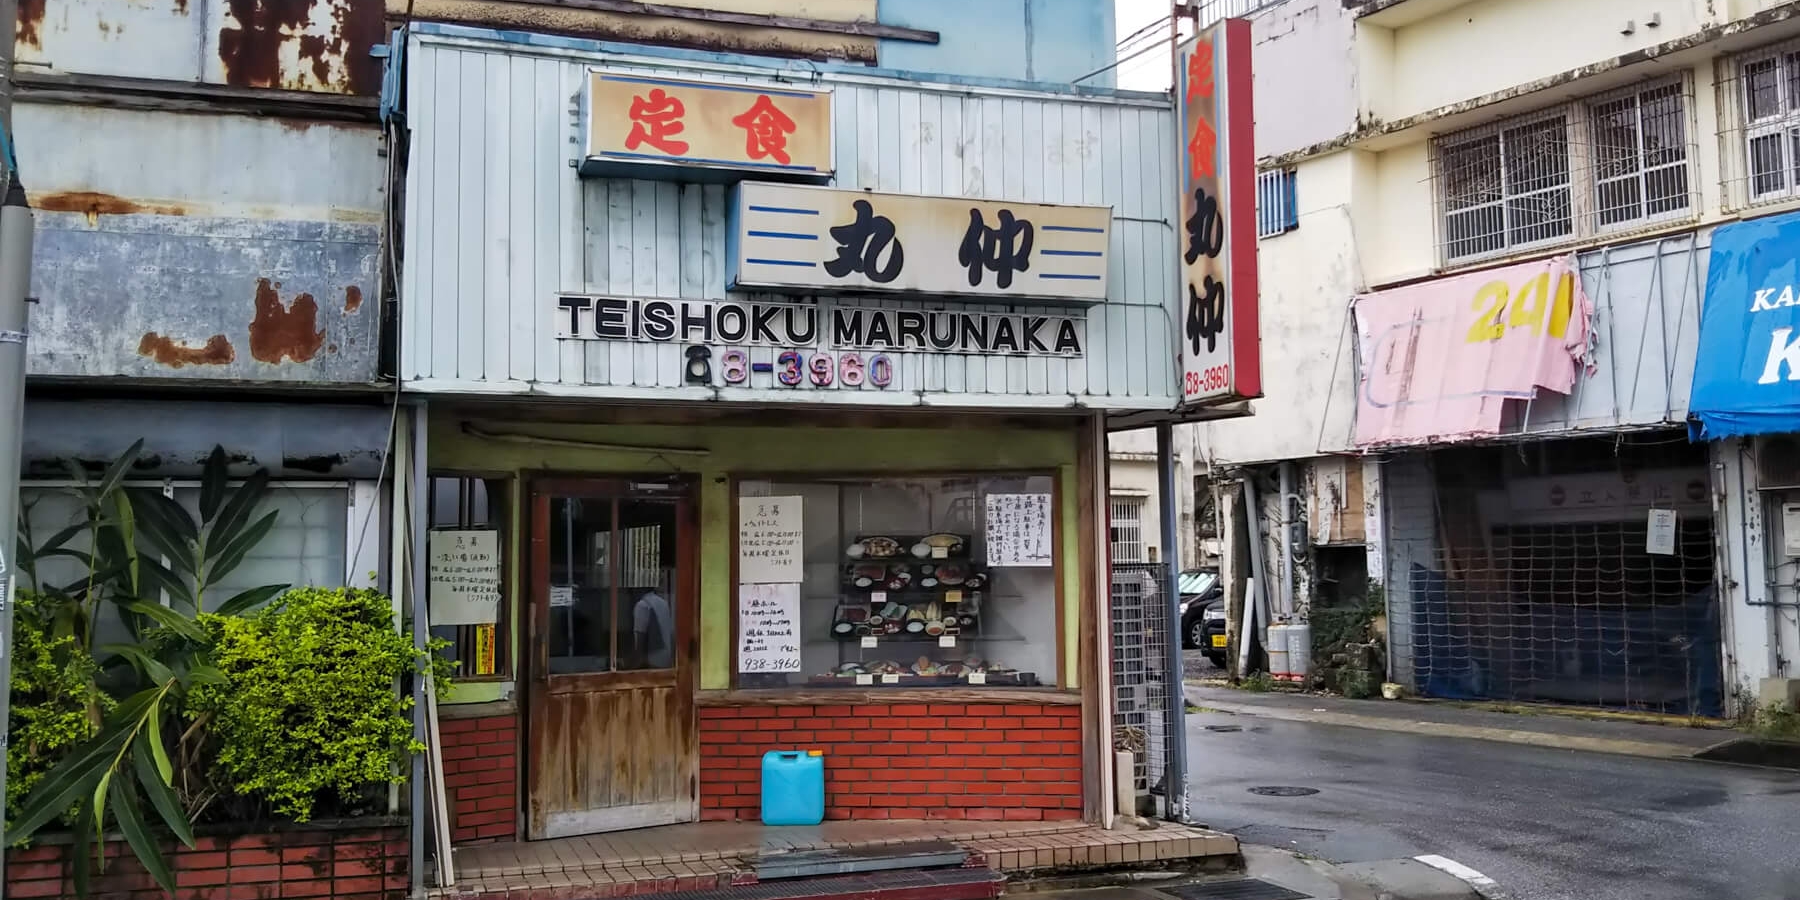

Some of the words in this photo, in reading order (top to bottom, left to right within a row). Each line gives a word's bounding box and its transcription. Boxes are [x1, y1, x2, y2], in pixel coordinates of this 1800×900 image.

[624, 88, 797, 165] 定食
[1186, 39, 1216, 181] 定食
[823, 199, 1034, 289] 丸仲
[1184, 187, 1225, 357] 丸仲
[558, 296, 817, 345] TEISHOKU
[832, 308, 1082, 355] MARUNAKA
[1750, 285, 1800, 312] KA
[722, 350, 893, 387] 8-3960
[745, 658, 800, 671] 938-3960
